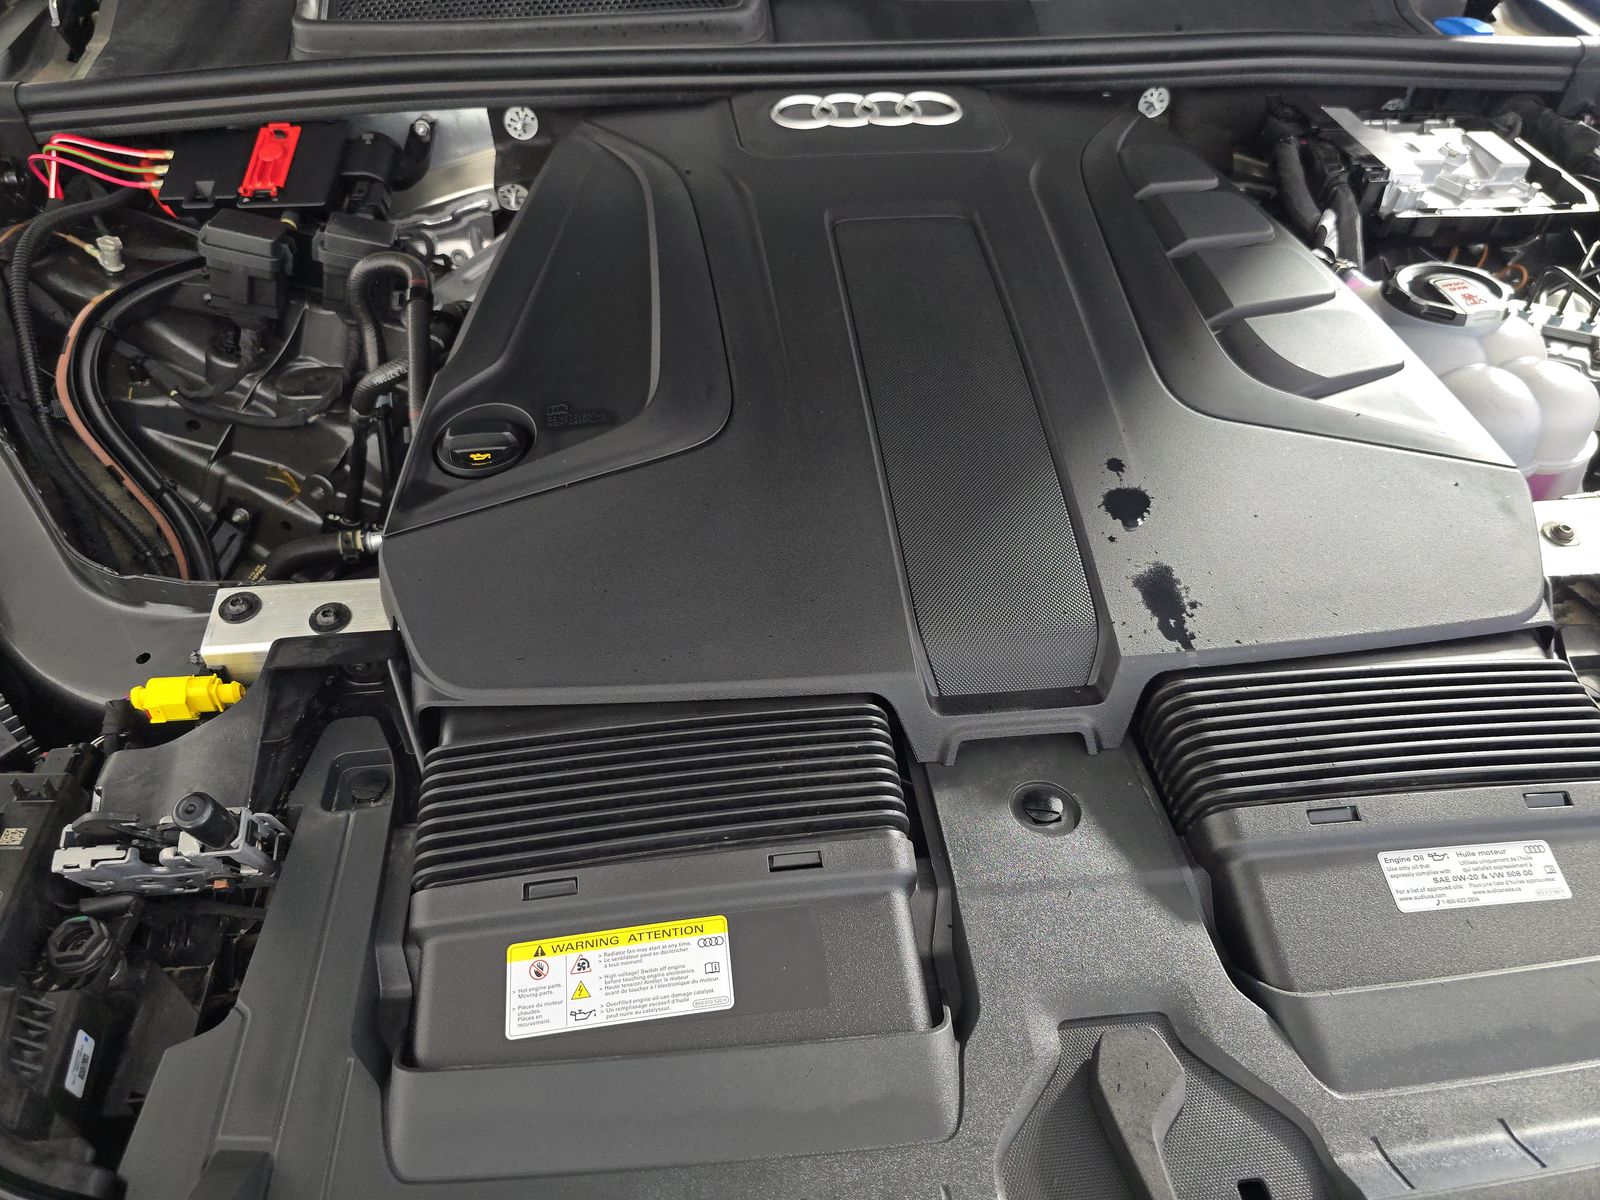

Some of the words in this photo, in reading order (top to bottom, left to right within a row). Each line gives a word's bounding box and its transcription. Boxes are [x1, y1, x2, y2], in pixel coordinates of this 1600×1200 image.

[1384, 856, 1412, 864] Engine
[1452, 874, 1478, 882] 0W-20
[1489, 871, 1504, 879] VW
[551, 936, 619, 953] WARNING
[628, 925, 704, 942] ATTENTION
[604, 949, 626, 957] Radiator
[640, 967, 658, 975] Switch
[668, 964, 686, 972] engine
[622, 975, 646, 984] touching
[646, 972, 665, 980] engine
[628, 985, 649, 993] toucher
[606, 999, 632, 1008] Overfilled
[632, 996, 651, 1004] engine
[670, 991, 693, 1000] damage
[615, 1003, 648, 1012] remplissage
[648, 999, 671, 1008] excessif
